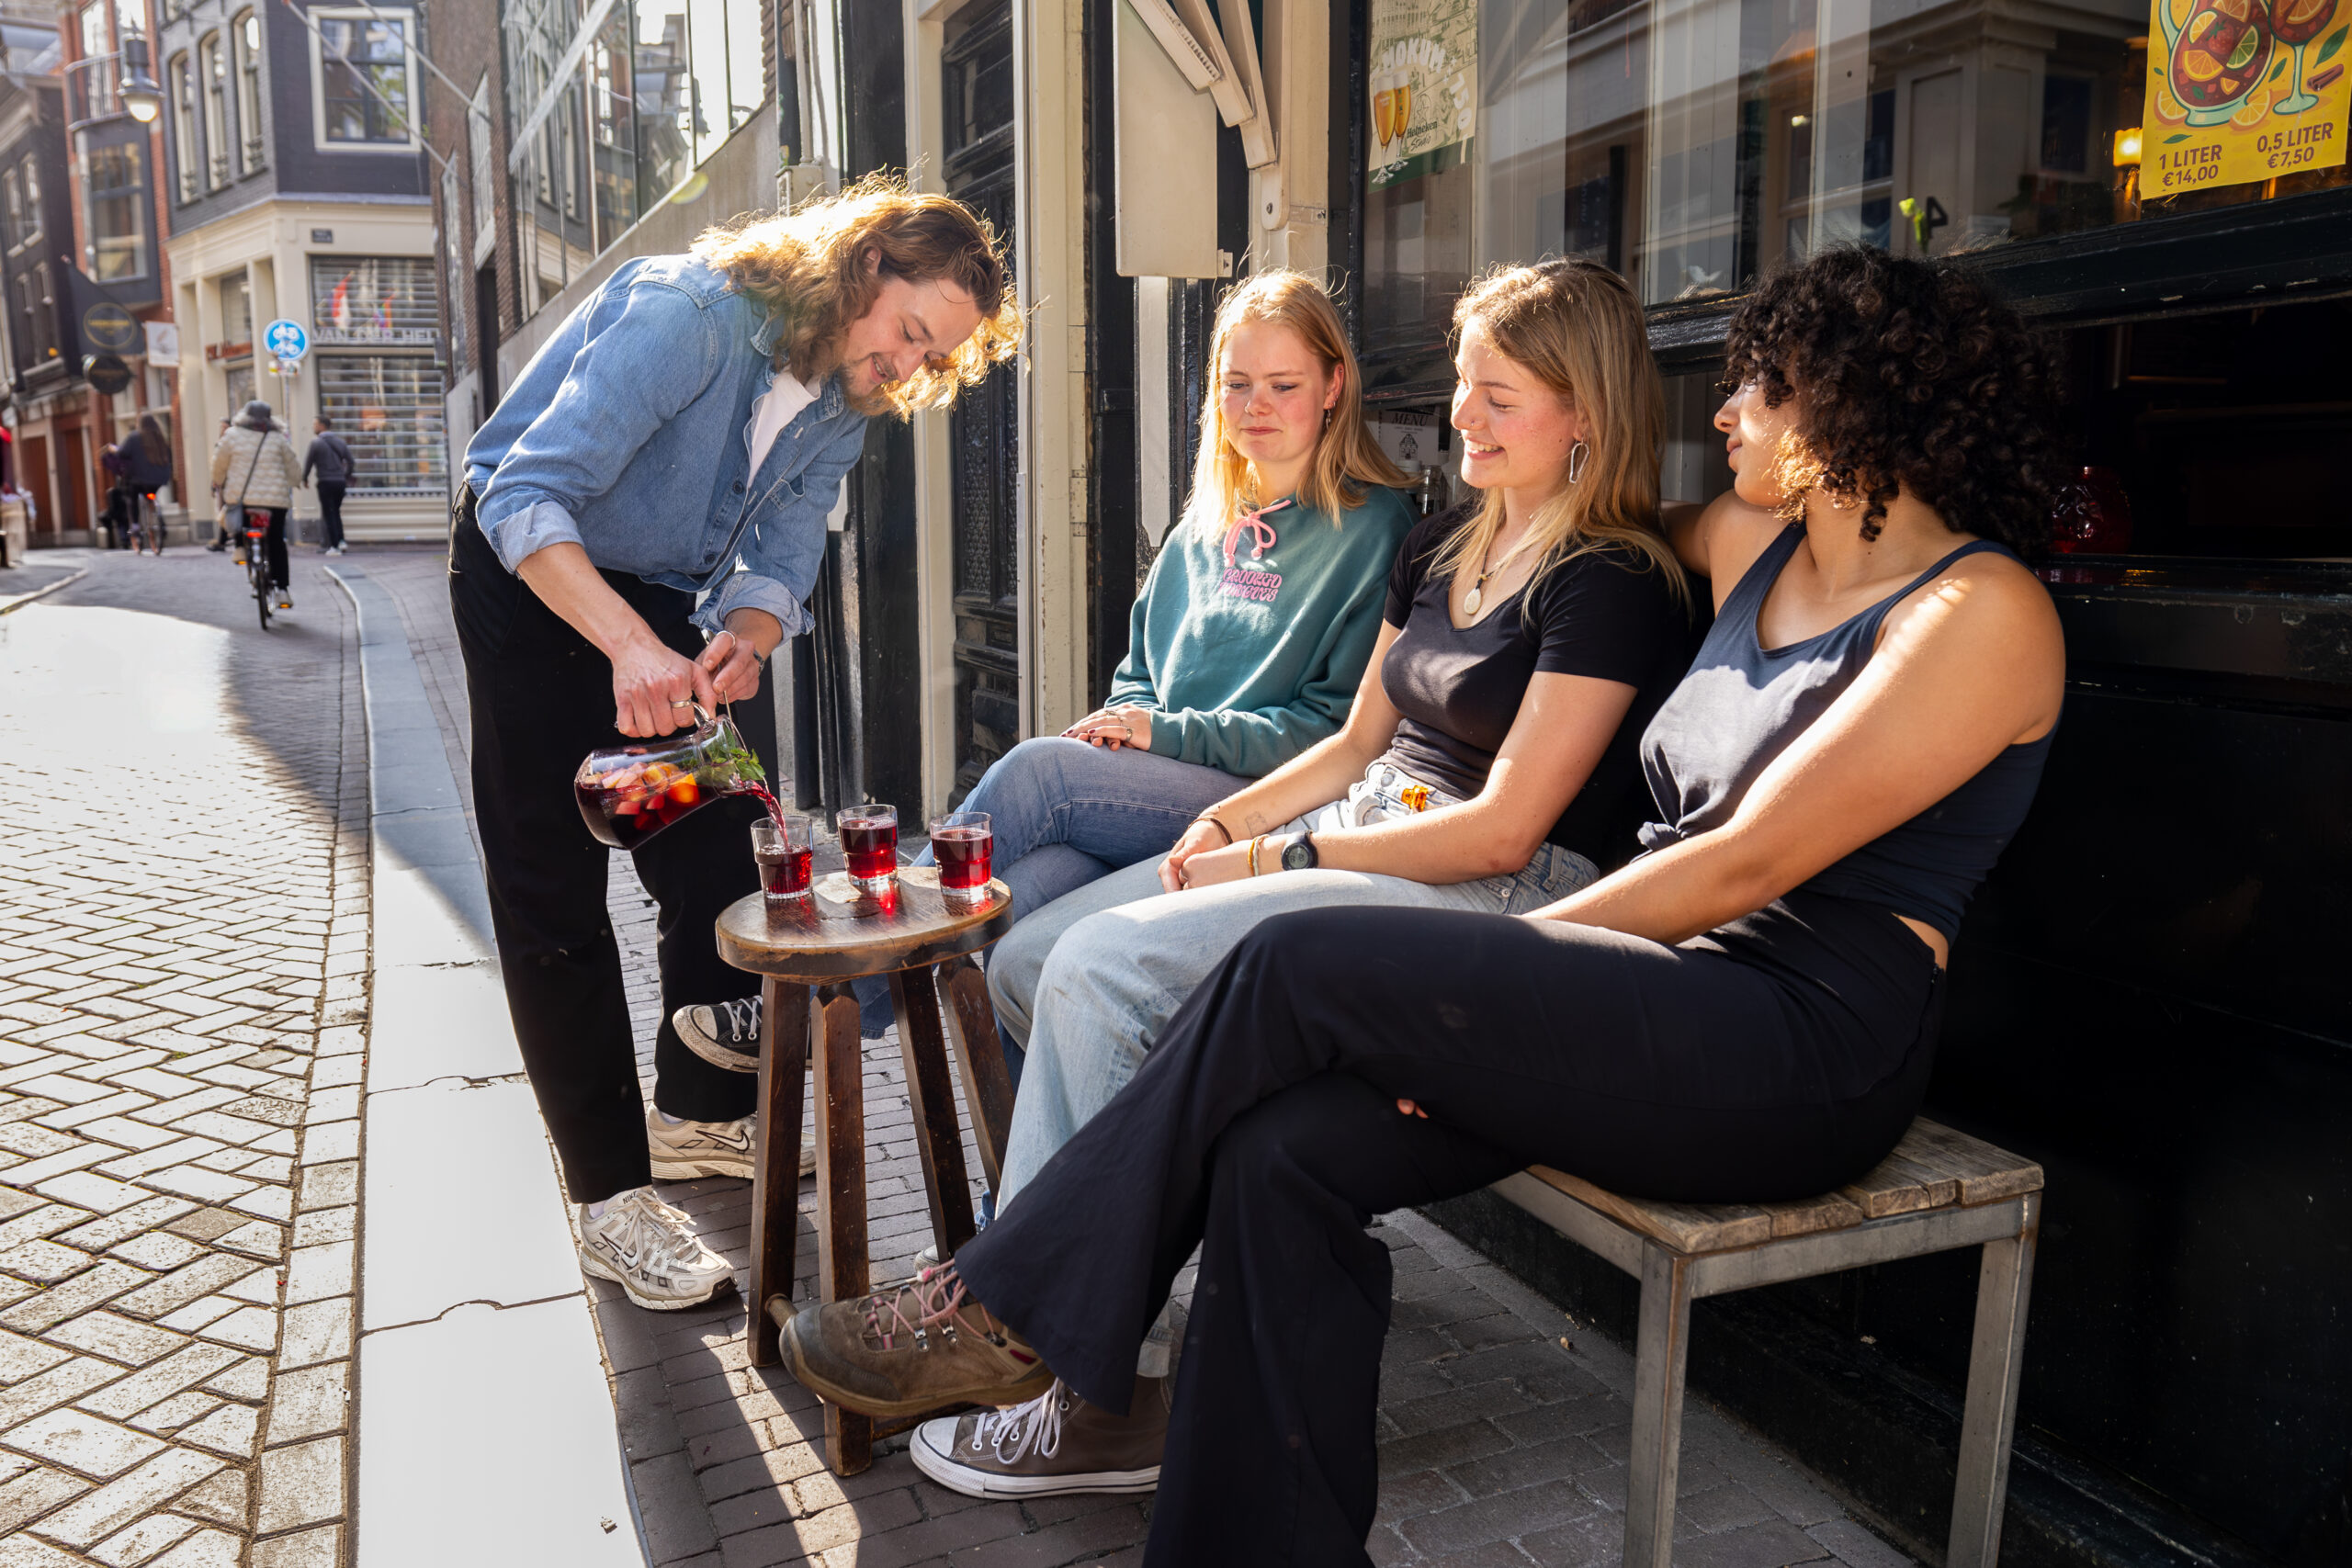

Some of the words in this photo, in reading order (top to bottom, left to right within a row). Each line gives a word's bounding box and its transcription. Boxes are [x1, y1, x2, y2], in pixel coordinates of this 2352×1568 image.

[1382, 38, 1445, 73] MOKUM
[1407, 121, 1438, 138] Heineken
[2256, 132, 2283, 153] 0,5
[2287, 122, 2335, 148] LITER
[2159, 153, 2166, 170] 1
[2173, 144, 2223, 168] LITER
[2267, 146, 2314, 169] €7,50
[2162, 164, 2219, 186] €14,00
[312, 328, 348, 343] VAN
[1389, 412, 1429, 427] MENU
[1223, 568, 1283, 589] CROOKED
